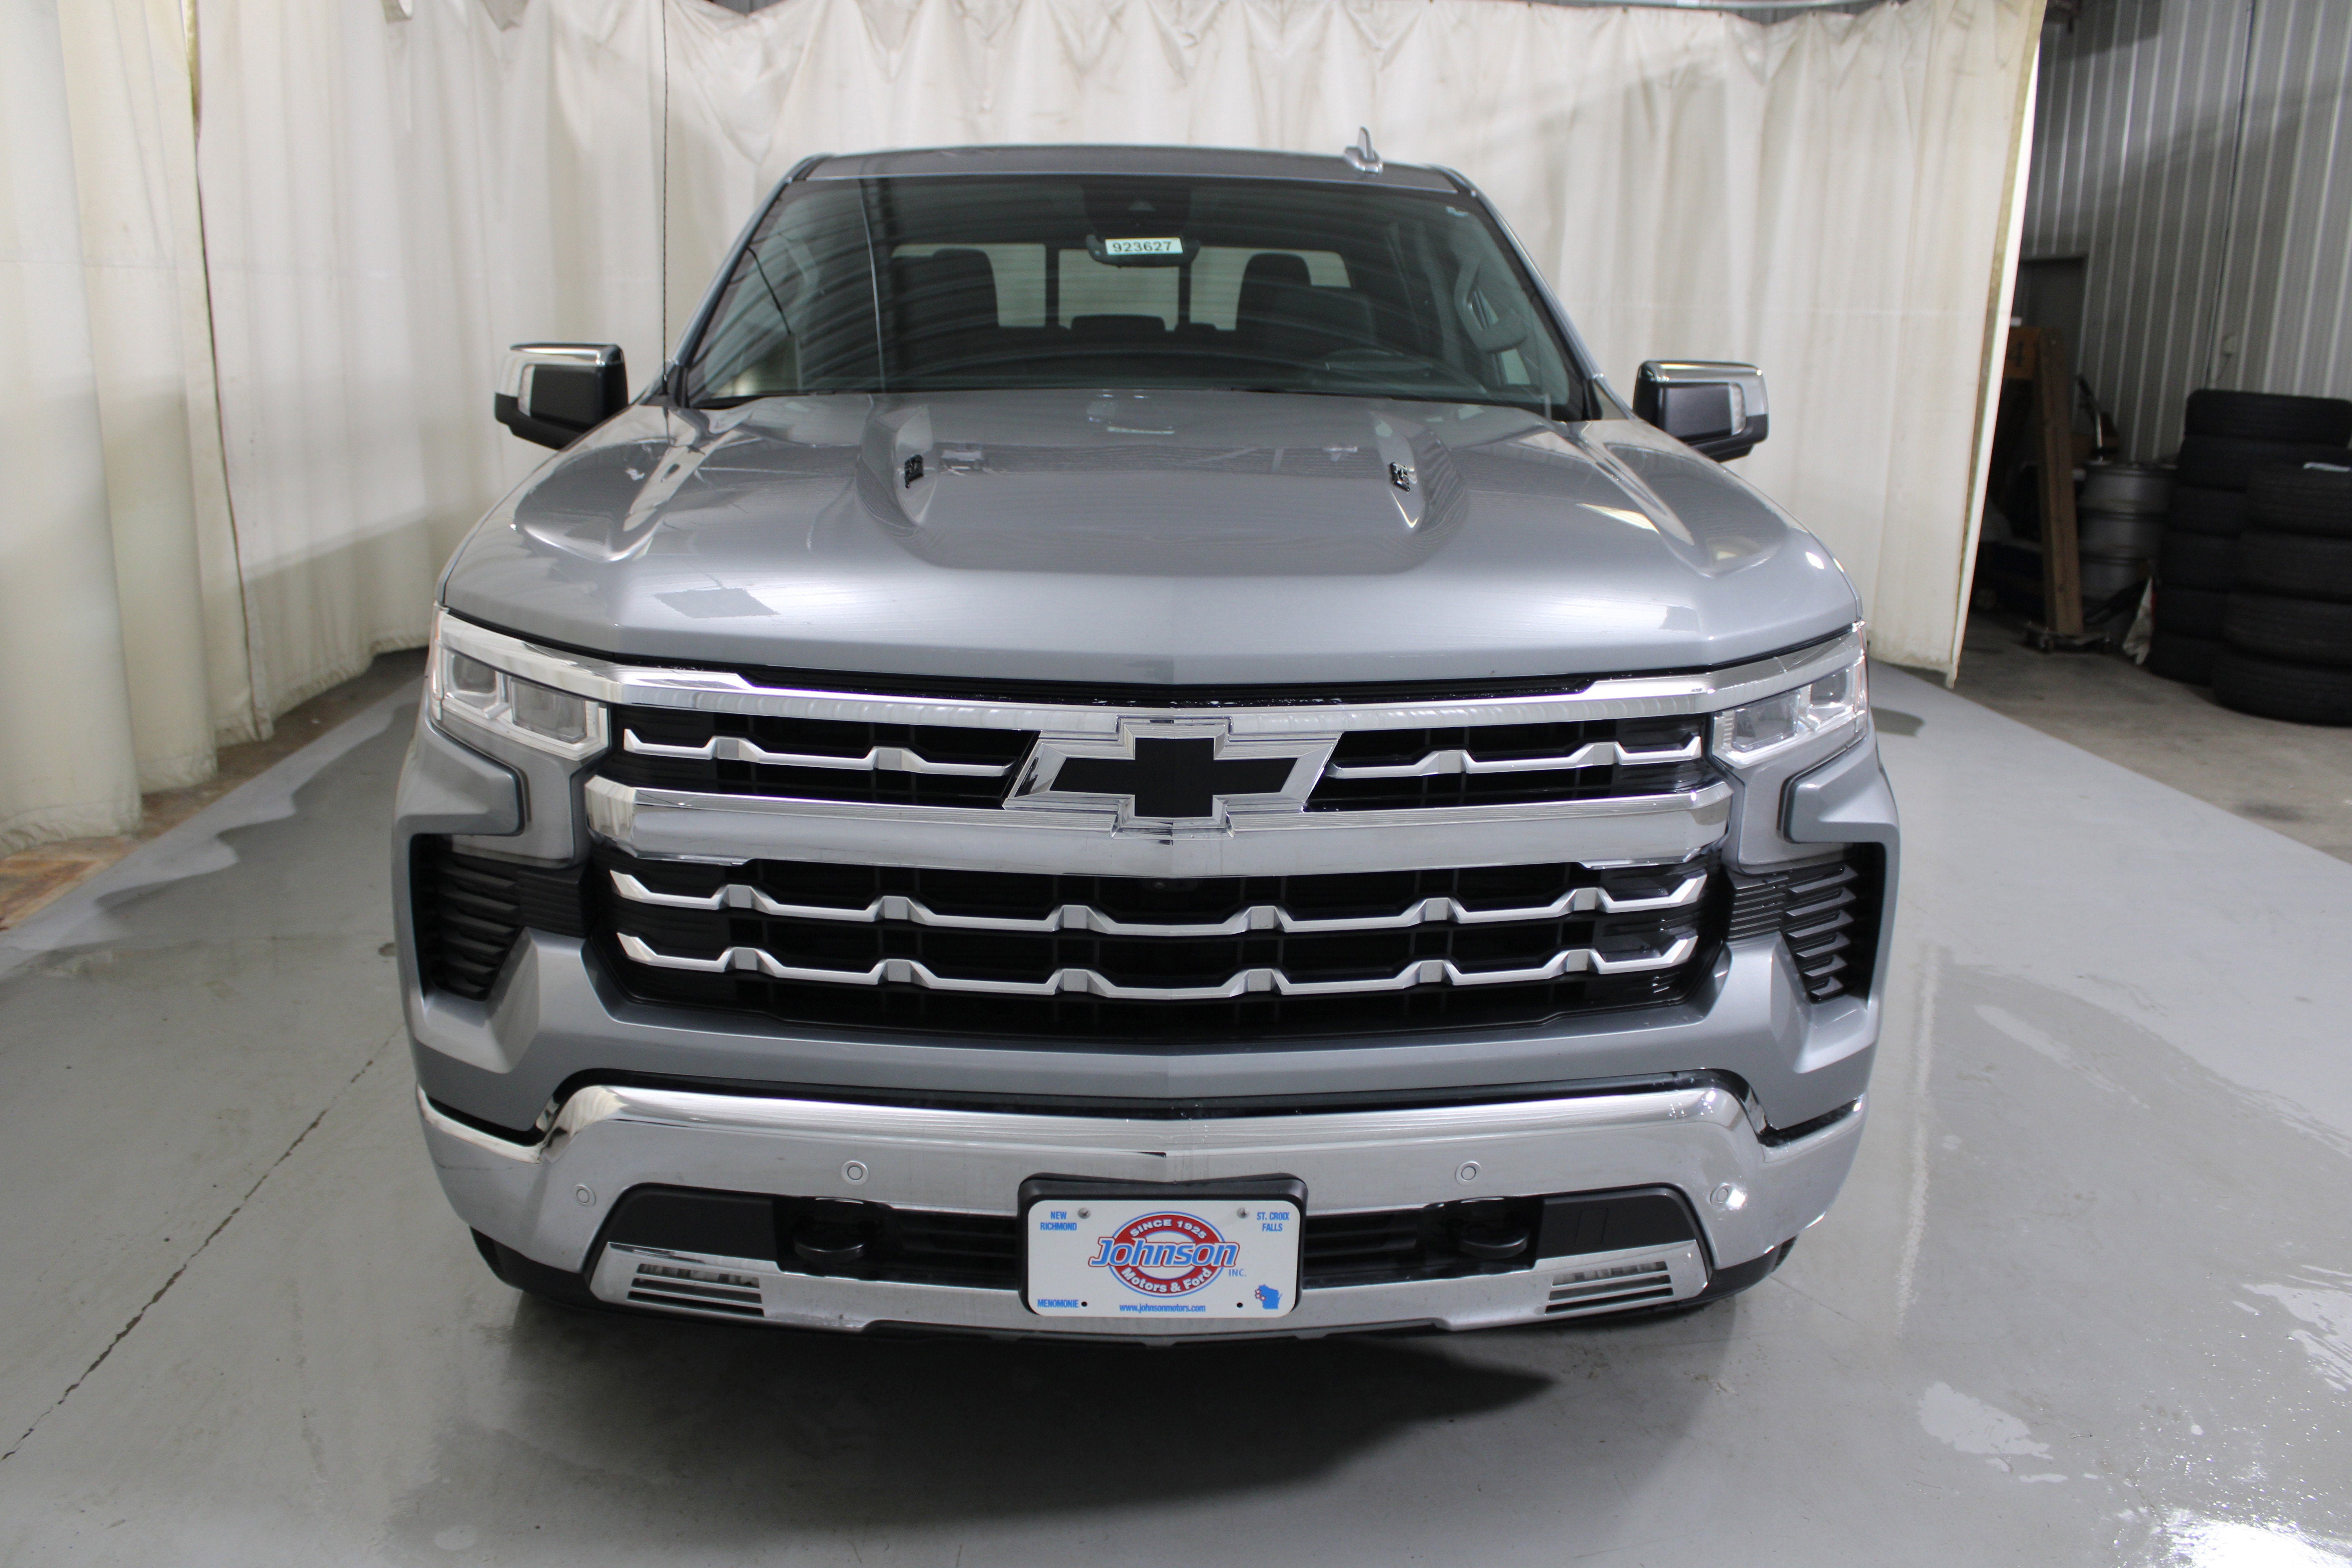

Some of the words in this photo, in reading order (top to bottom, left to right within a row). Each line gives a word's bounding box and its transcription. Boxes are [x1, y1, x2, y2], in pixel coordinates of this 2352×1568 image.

[1112, 240, 1172, 252] 923627
[1050, 1211, 1067, 1220] NEW
[1256, 1212, 1267, 1221] ST.
[1269, 1212, 1290, 1221] CROIX
[1040, 1222, 1077, 1231] RICHMOND
[1129, 1218, 1172, 1238] SINCE
[1177, 1220, 1207, 1239] 1925
[1262, 1223, 1283, 1232] FALLS
[1090, 1238, 1239, 1266] Johnson
[1228, 1269, 1247, 1277] INC.
[1120, 1267, 1168, 1292] Motors
[1170, 1282, 1182, 1292] &
[1183, 1267, 1213, 1290] Ford
[1037, 1299, 1079, 1308] MENOMONIE
[1119, 1303, 1206, 1314] www.johnsonmotors.com
